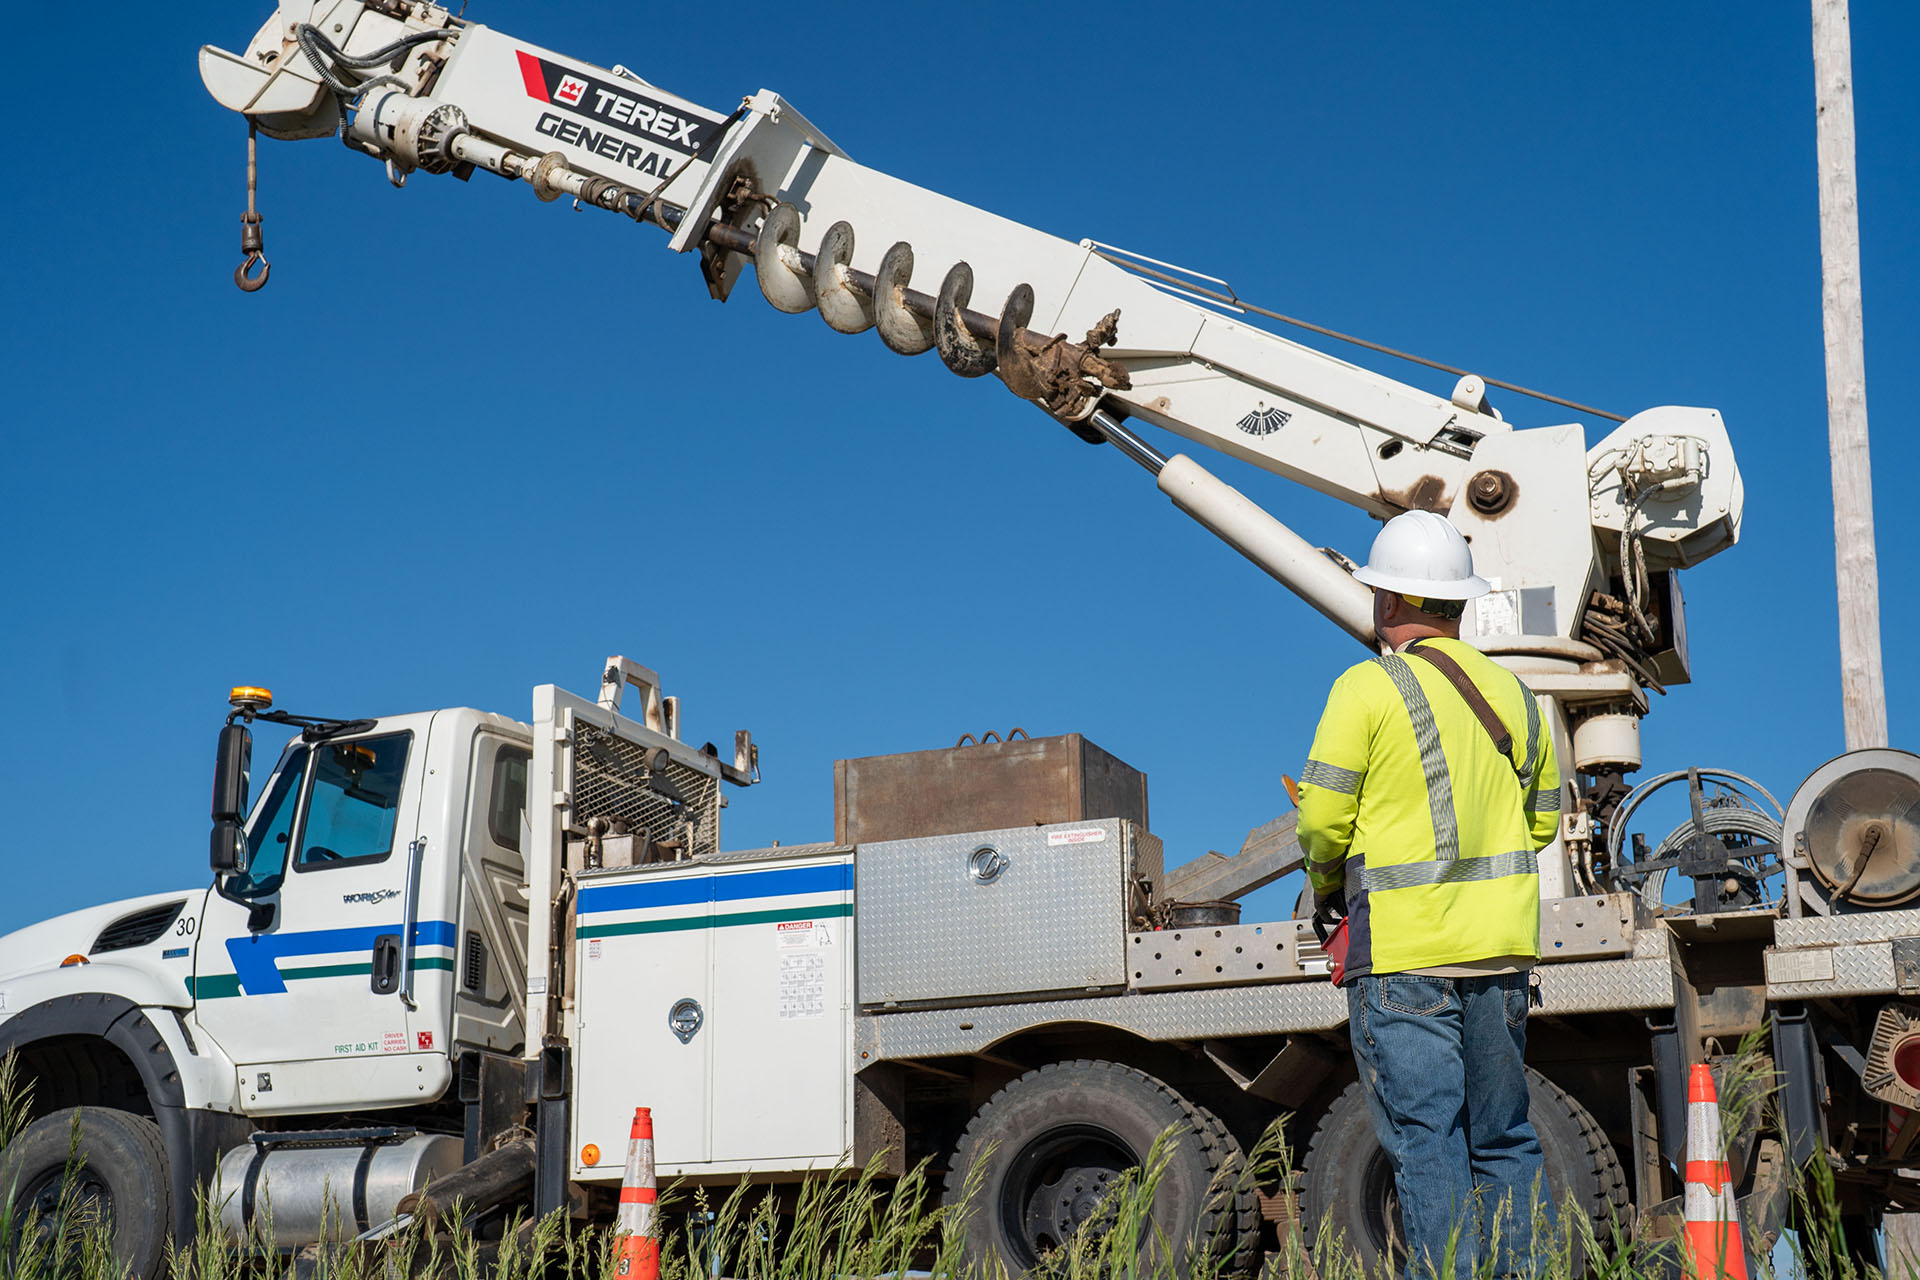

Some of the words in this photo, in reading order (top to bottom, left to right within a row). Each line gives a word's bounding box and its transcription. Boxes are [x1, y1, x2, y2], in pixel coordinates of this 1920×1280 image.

[594, 88, 700, 147] TEREX
[535, 112, 673, 180] GENERAL
[176, 917, 195, 936] 30
[785, 922, 811, 930] DANGER
[334, 1044, 352, 1054] FIRST
[355, 1043, 366, 1052] AID
[368, 1042, 378, 1050] KIT
